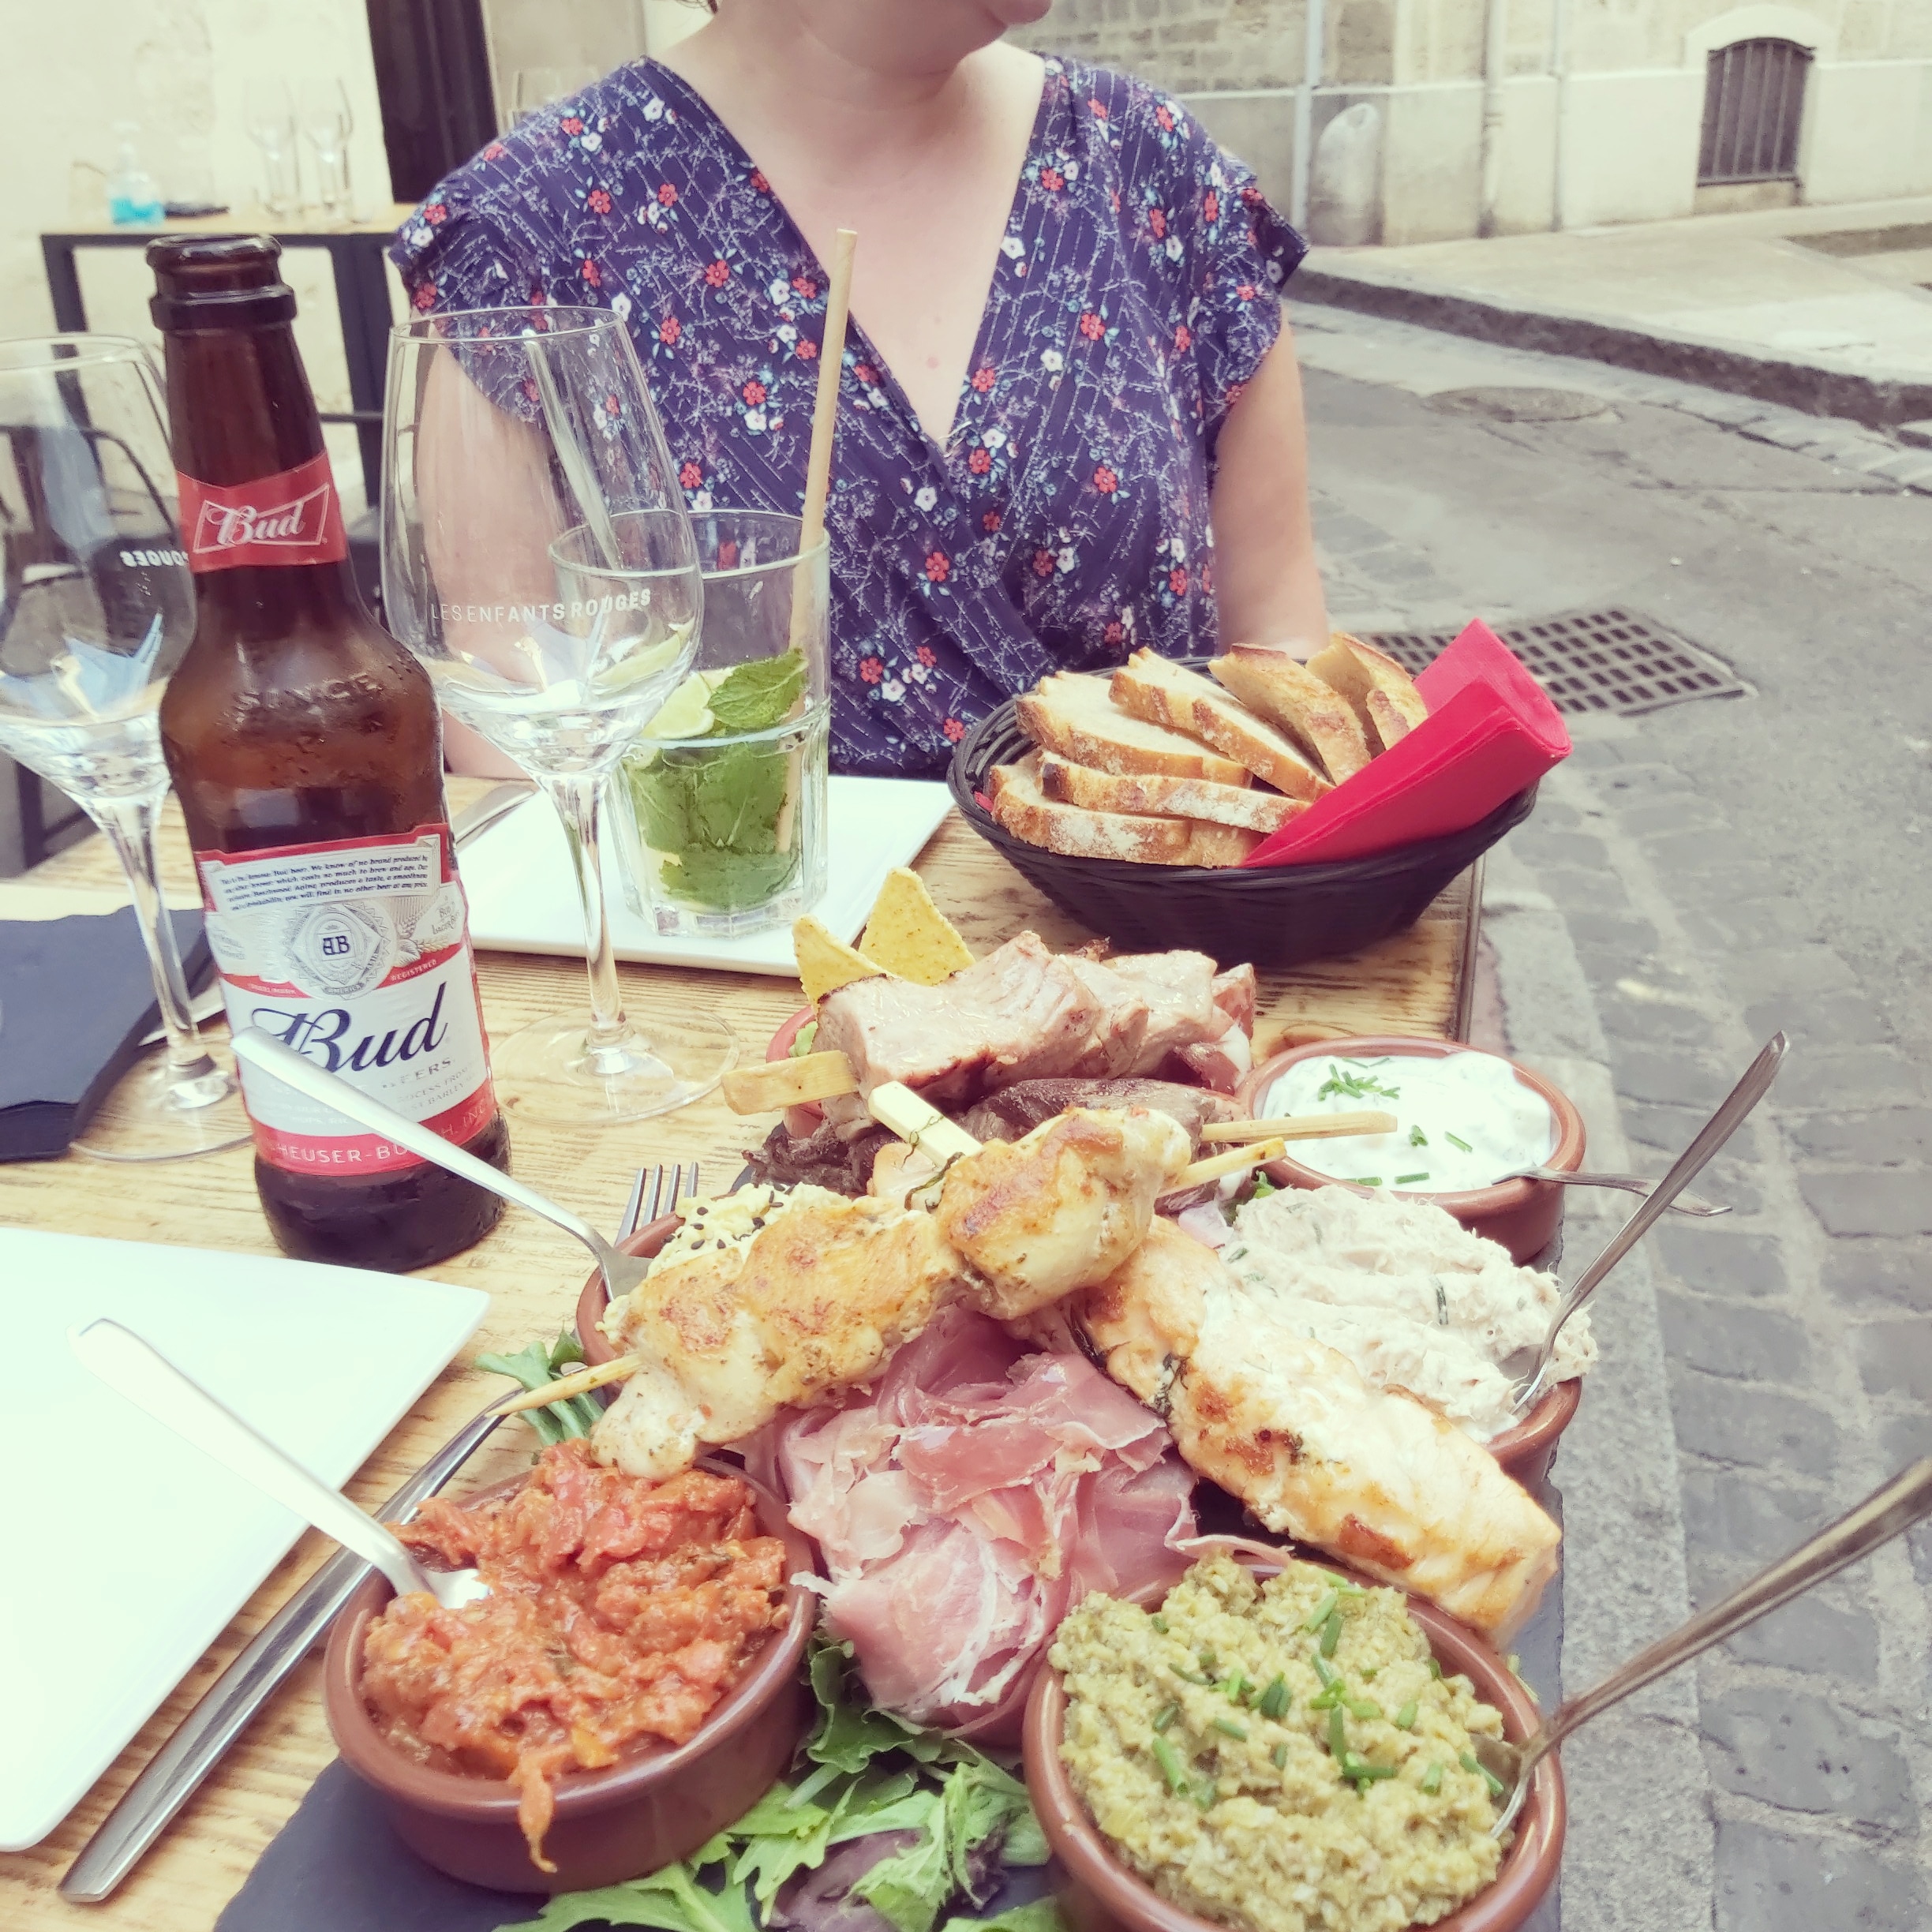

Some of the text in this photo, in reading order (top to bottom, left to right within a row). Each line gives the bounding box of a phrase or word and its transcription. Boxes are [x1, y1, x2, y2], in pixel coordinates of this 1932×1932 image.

[205, 500, 306, 545] Bud
[467, 603, 566, 623] ENFANTS
[571, 588, 652, 619] ROUGES
[251, 981, 449, 1073] Bud
